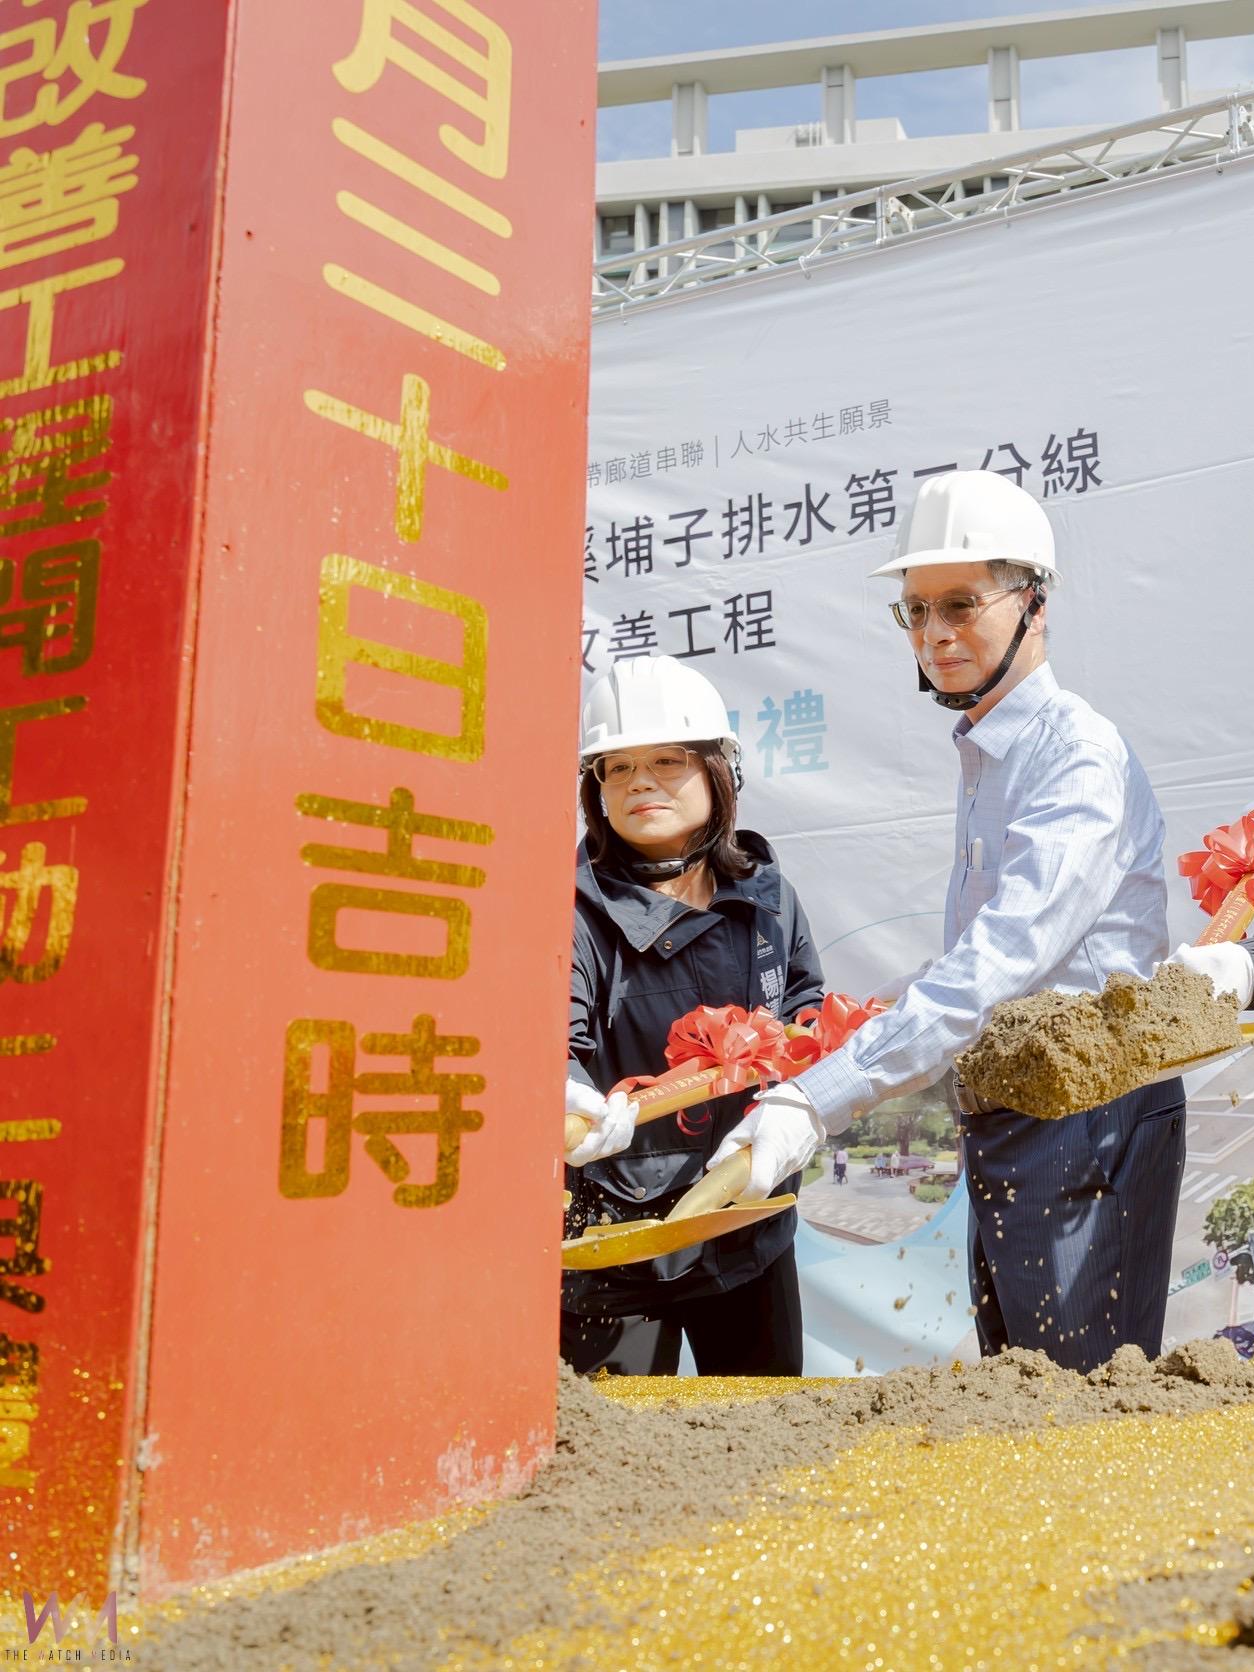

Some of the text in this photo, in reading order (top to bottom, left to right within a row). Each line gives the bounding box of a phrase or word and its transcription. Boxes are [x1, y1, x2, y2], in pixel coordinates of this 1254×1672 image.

[731, 398, 893, 459] 人水共生願景
